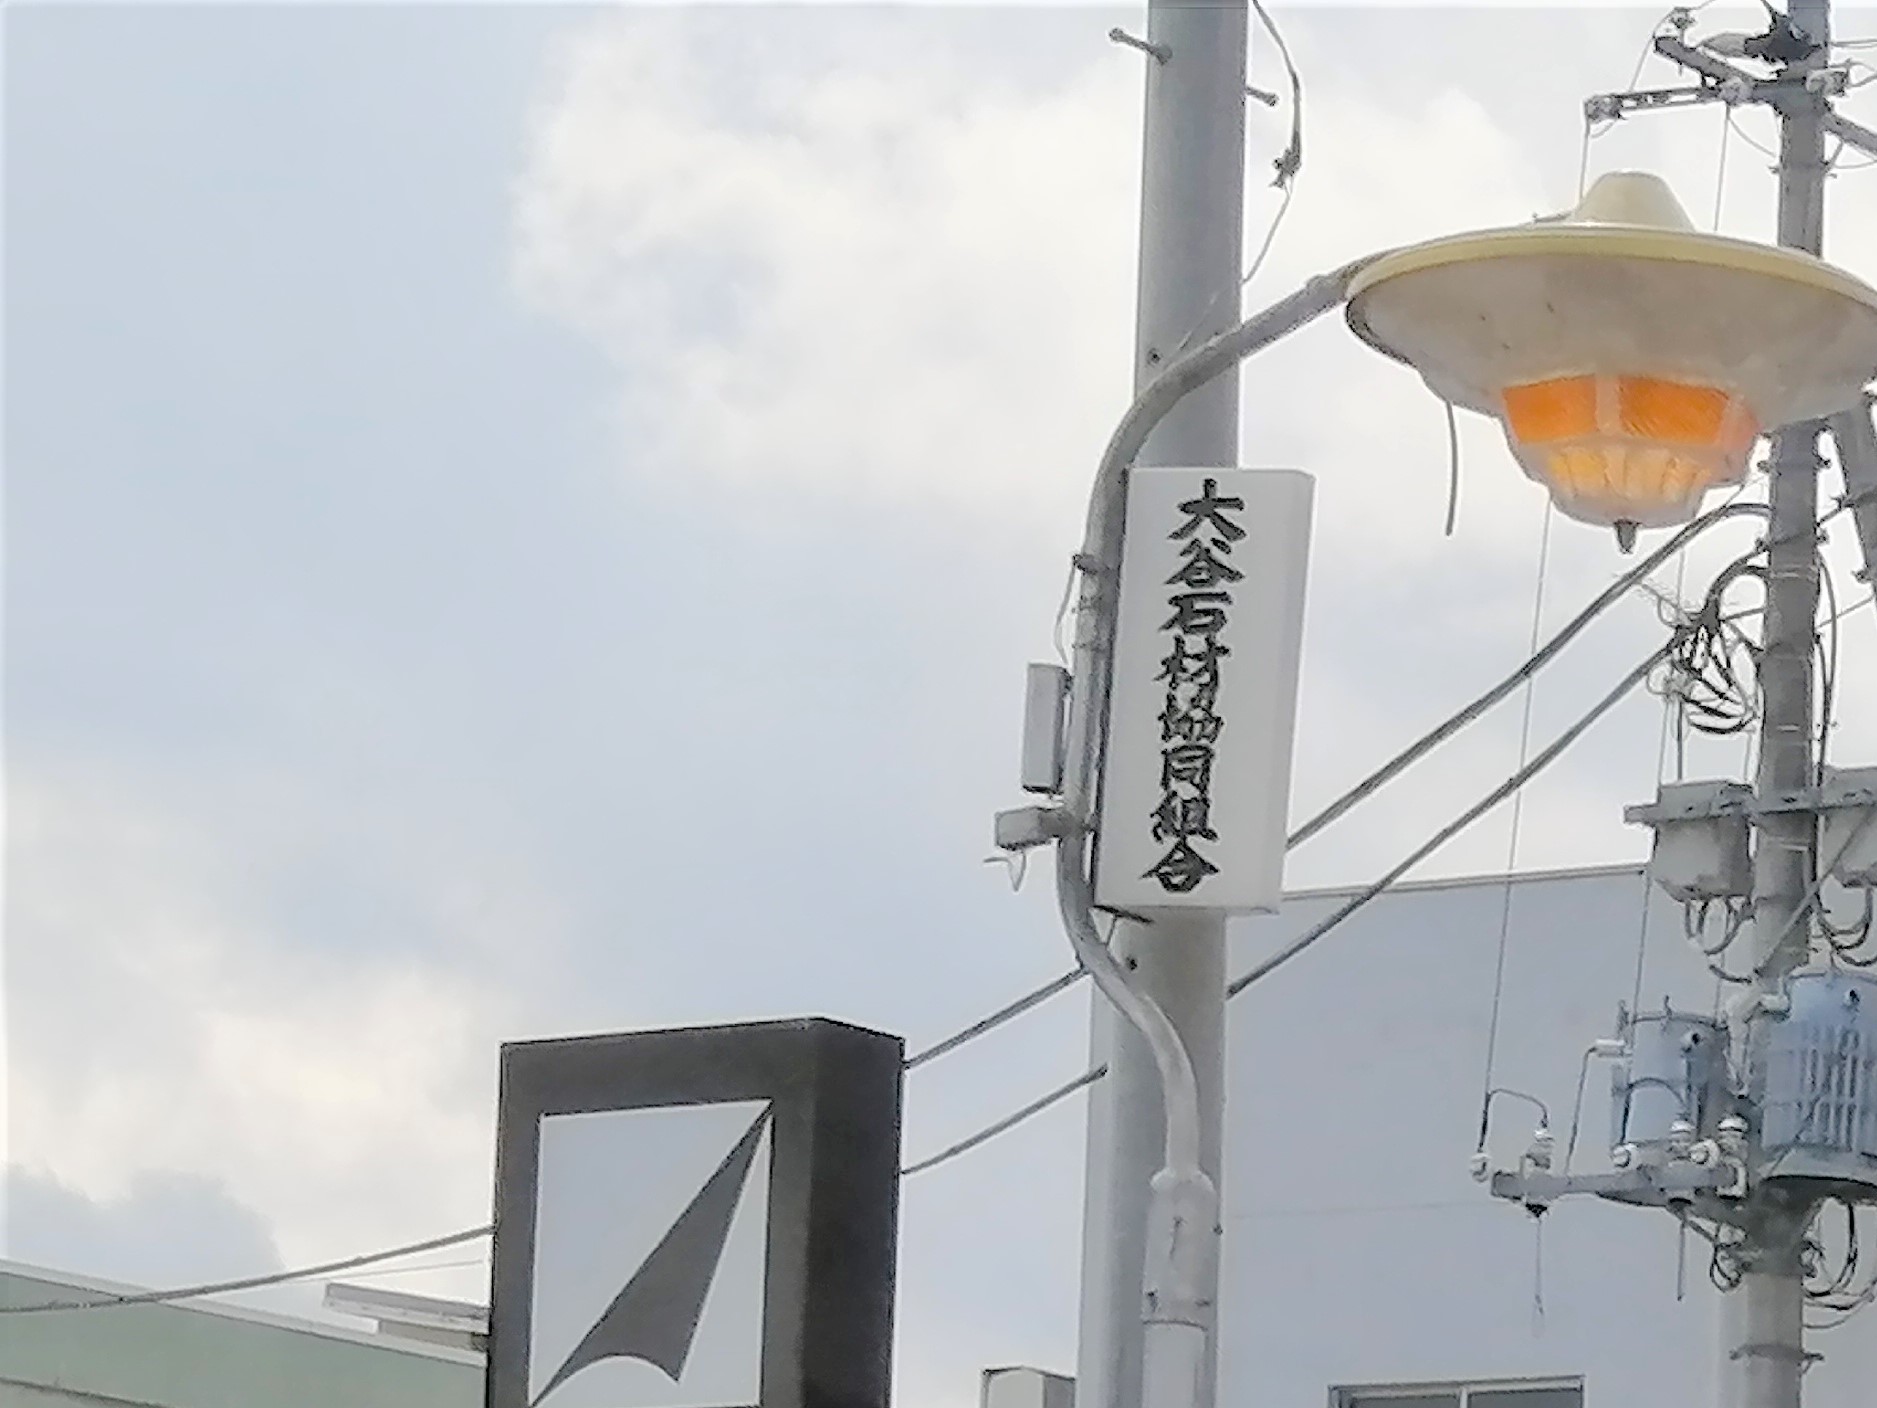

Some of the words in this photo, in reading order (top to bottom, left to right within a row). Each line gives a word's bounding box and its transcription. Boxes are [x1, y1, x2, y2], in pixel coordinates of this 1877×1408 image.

[1140, 478, 1247, 894] 大谷石材協同組合
